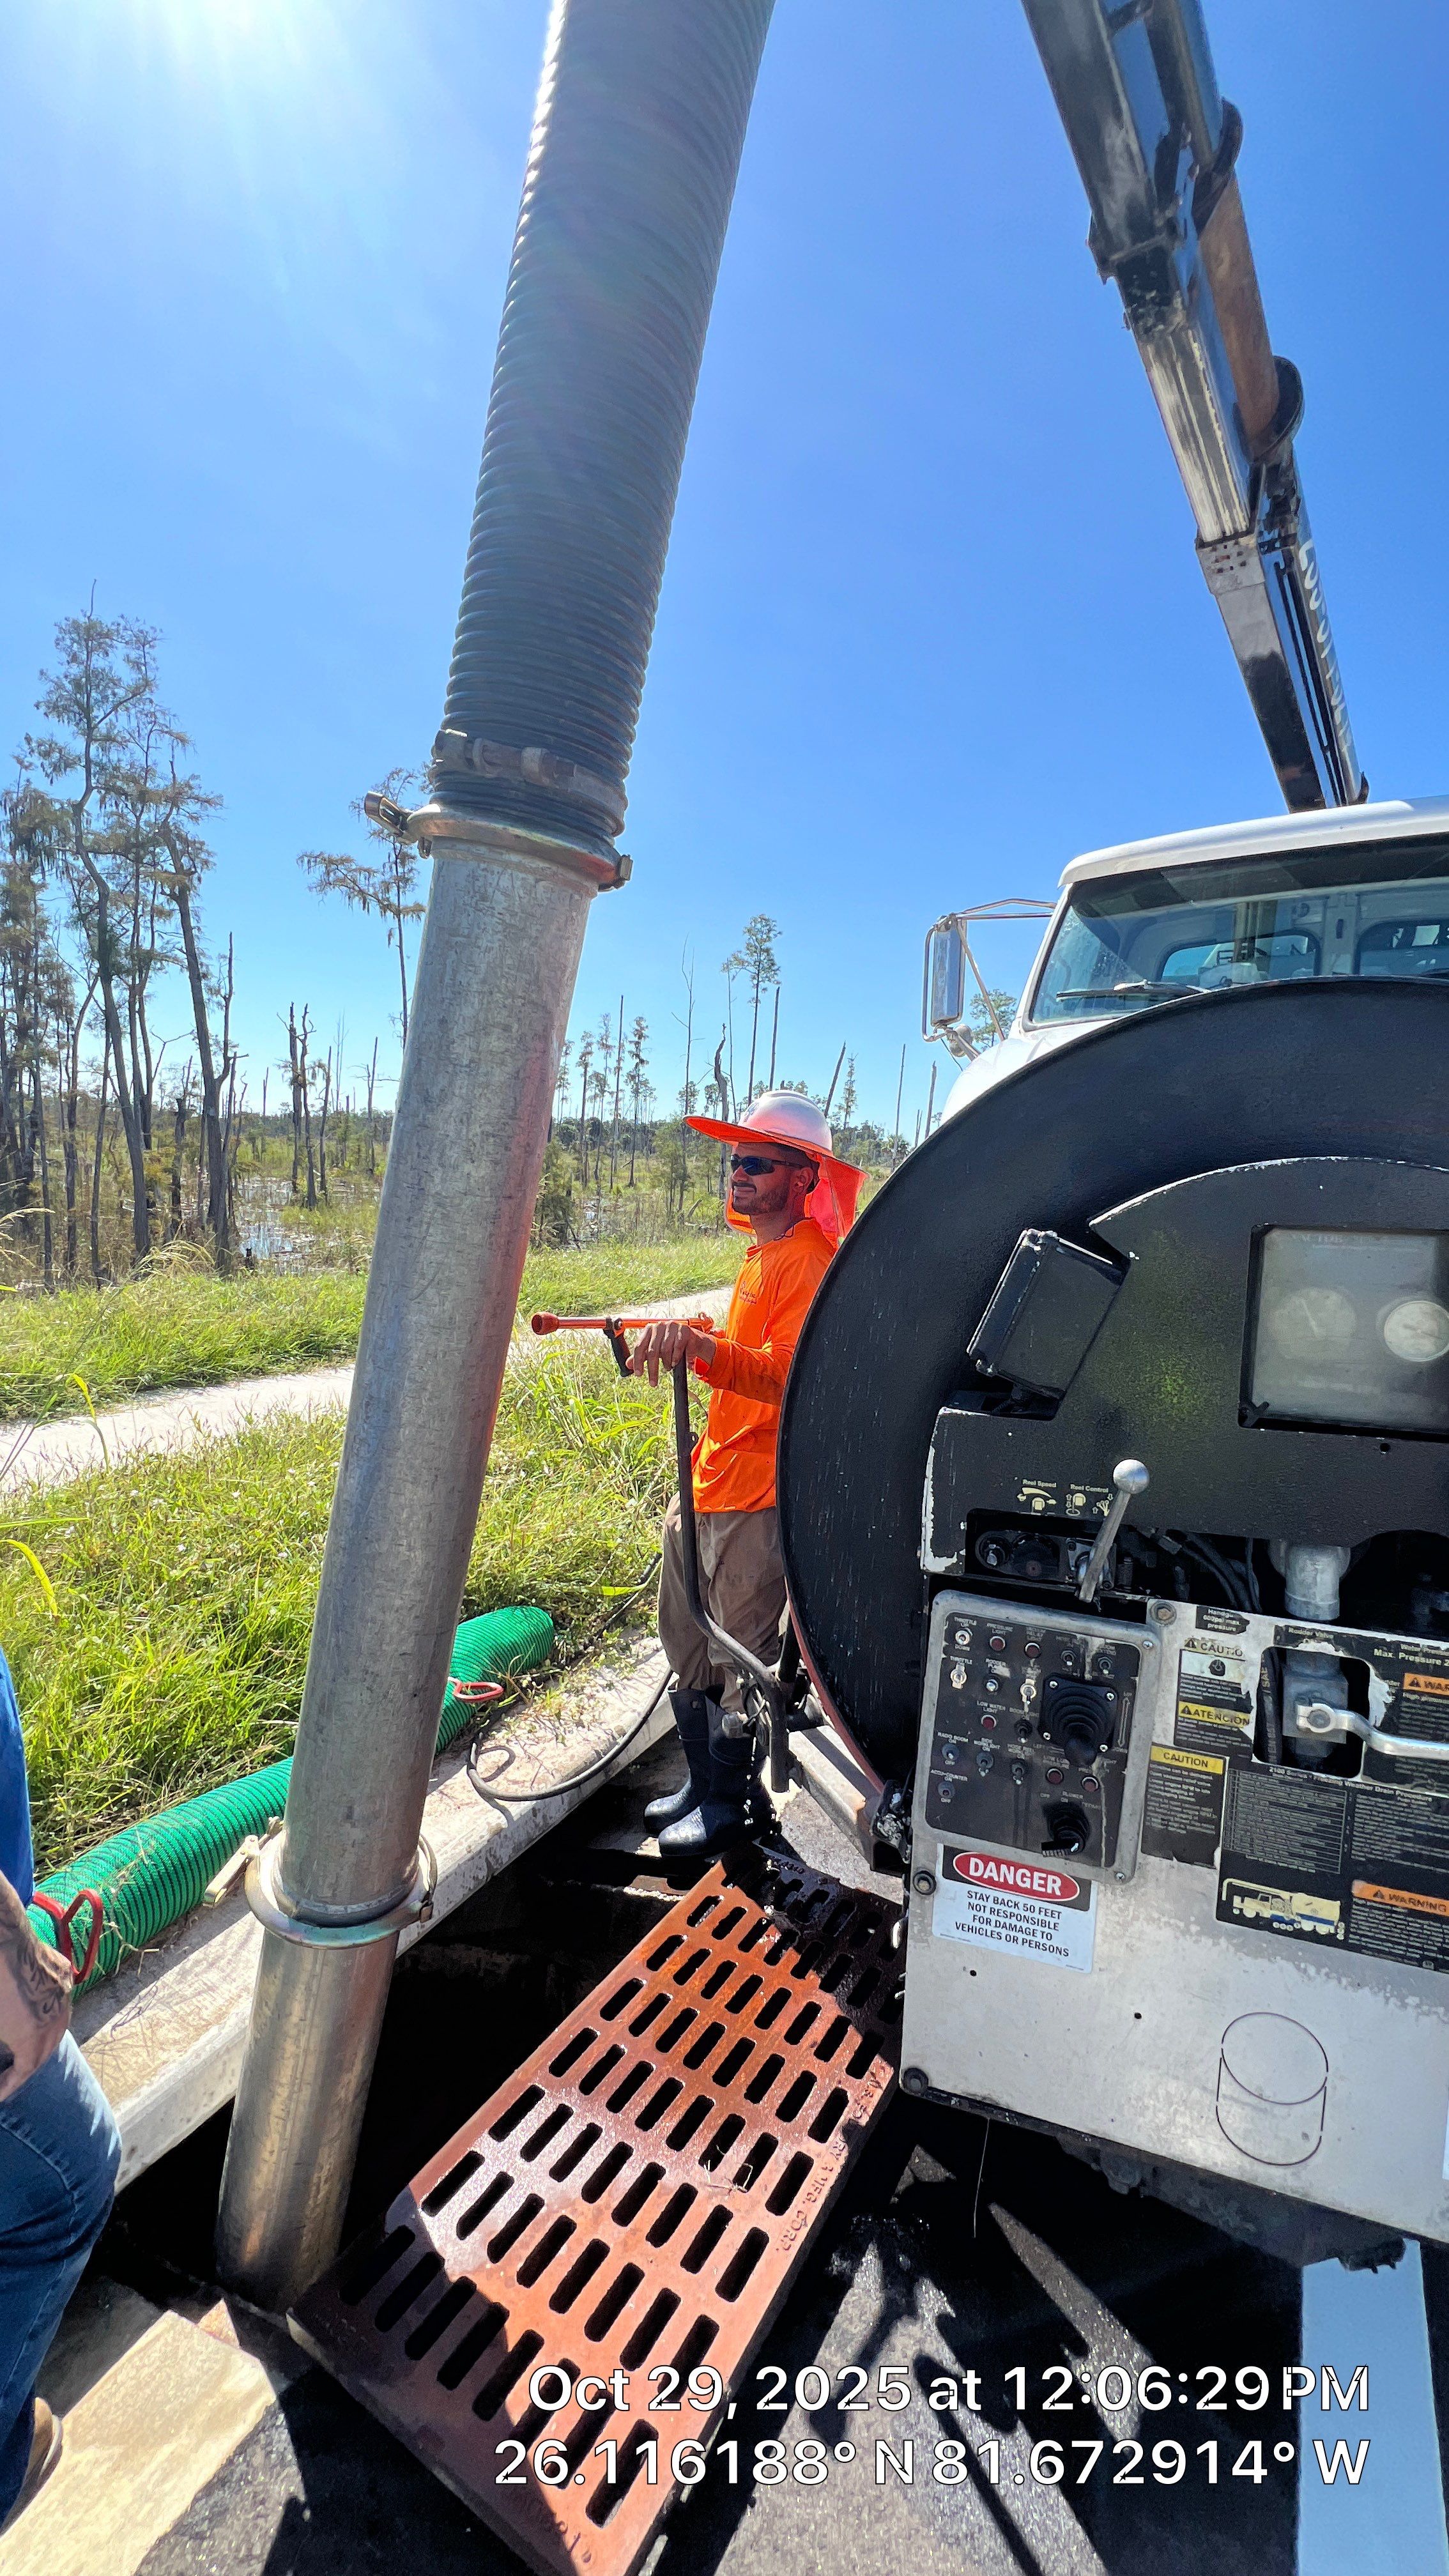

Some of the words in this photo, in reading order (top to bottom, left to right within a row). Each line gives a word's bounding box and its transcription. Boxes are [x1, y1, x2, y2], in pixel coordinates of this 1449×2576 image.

[1399, 1652, 1442, 1666] Pressure
[1163, 1751, 1209, 1768] CAUTION
[1375, 1786, 1395, 1795] Drain
[969, 1857, 1062, 1896] DANGER
[967, 1890, 990, 1903] STAY
[993, 1896, 1020, 1910] BACK
[1023, 1903, 1036, 1913] 50
[1038, 1907, 1062, 1920] FEET
[1388, 1893, 1446, 1912] WARNING
[967, 1903, 986, 1913] NOT
[990, 1907, 1059, 1931] RESPONSIBLE
[972, 1914, 992, 1926] FOR
[994, 1920, 1038, 1938] DAMAGE
[1039, 1930, 1053, 1941] TO
[955, 1922, 1002, 1940] VEHICLES
[1005, 1933, 1019, 1944] OR
[1022, 1938, 1070, 1958] PERSONS
